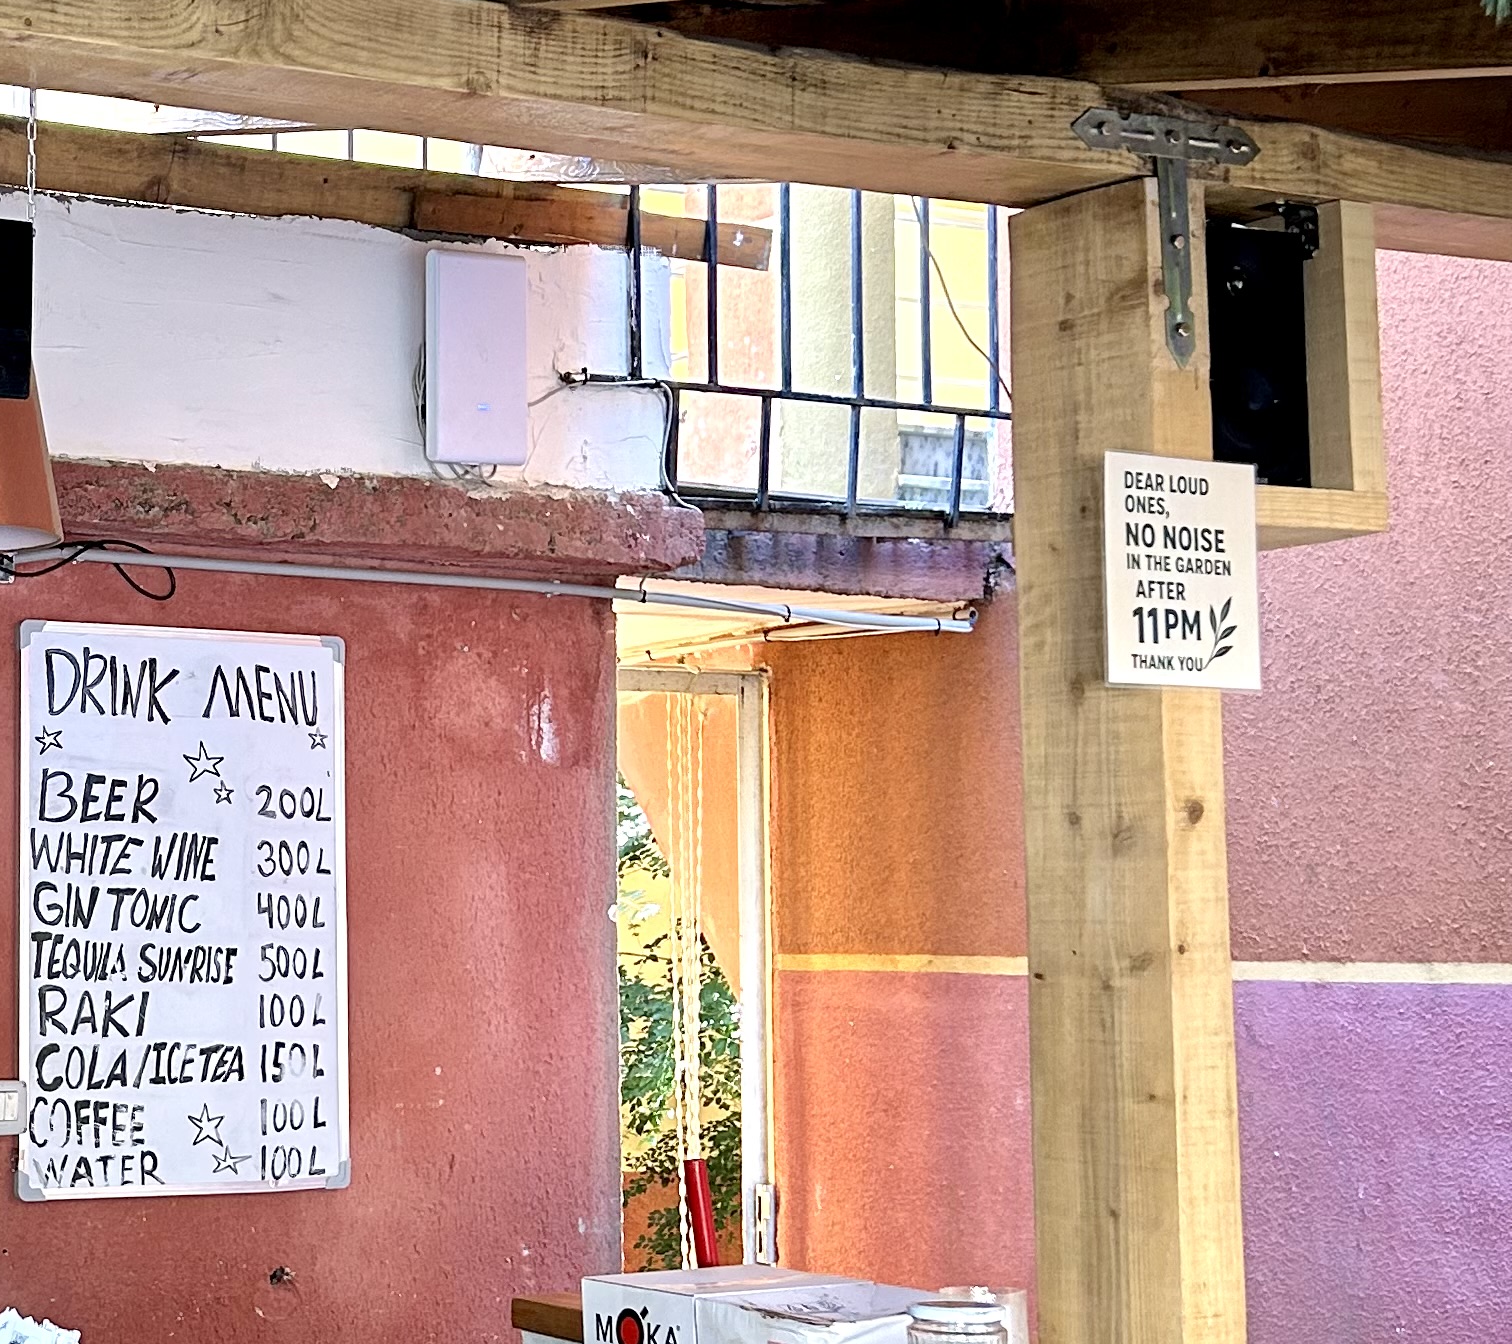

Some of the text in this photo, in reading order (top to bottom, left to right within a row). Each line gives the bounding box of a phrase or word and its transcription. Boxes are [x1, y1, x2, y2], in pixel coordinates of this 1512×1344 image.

[1124, 471, 1209, 496] DEAR LOUD
[1125, 494, 1170, 518] ONES,
[1125, 522, 1225, 553] NO NOISE
[1126, 553, 1231, 576] IN THE GARDEN
[1136, 580, 1186, 601] AFTER
[1131, 654, 1203, 672] THANK YOU
[45, 647, 318, 726] DRINK MENU
[39, 768, 159, 824] BEER
[30, 828, 144, 876] WHITE
[151, 832, 219, 881] WINE
[33, 881, 100, 929] GIN
[107, 887, 201, 933] TONIC
[31, 931, 128, 982] TEQUILA
[138, 942, 237, 984] SUNRISE
[38, 984, 150, 1038] RAKI
[29, 1096, 145, 1148] COFFEE
[32, 1150, 166, 1189] WATER
